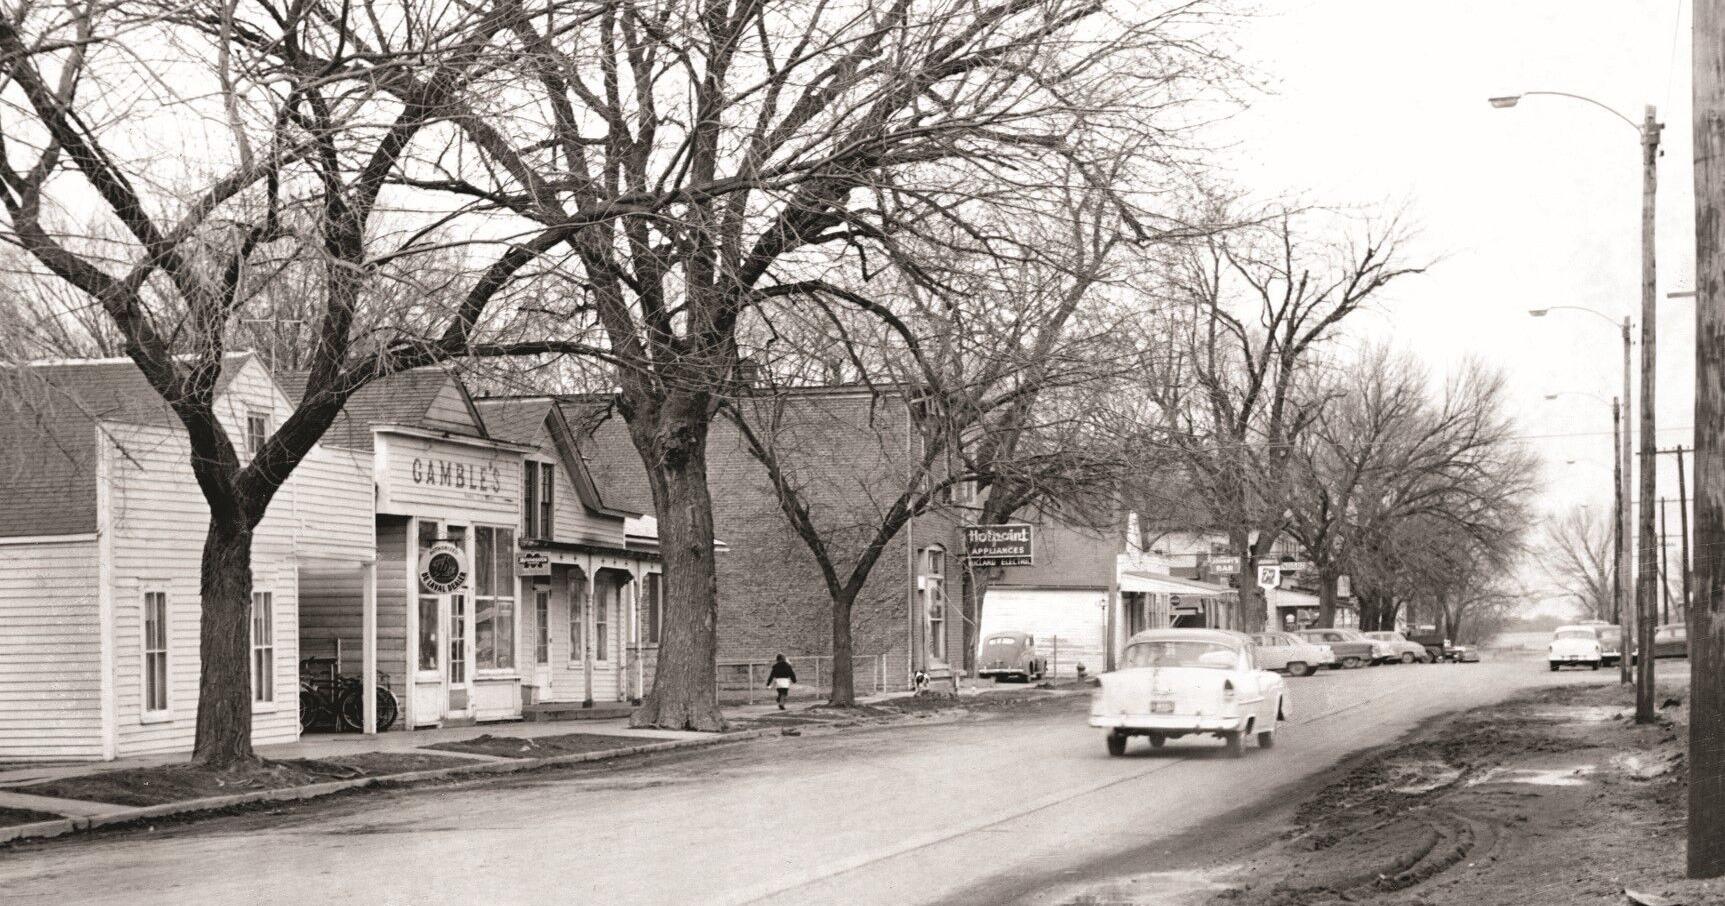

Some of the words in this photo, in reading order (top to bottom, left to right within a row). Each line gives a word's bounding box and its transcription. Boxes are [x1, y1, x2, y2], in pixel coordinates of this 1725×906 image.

[412, 458, 500, 493] GAMBLE'S
[969, 528, 1029, 547] Hotpoint
[972, 547, 1025, 555] APPLIANCES
[421, 572, 430, 581] DE
[427, 580, 446, 592] LAVAL
[447, 572, 466, 591] DEALER
